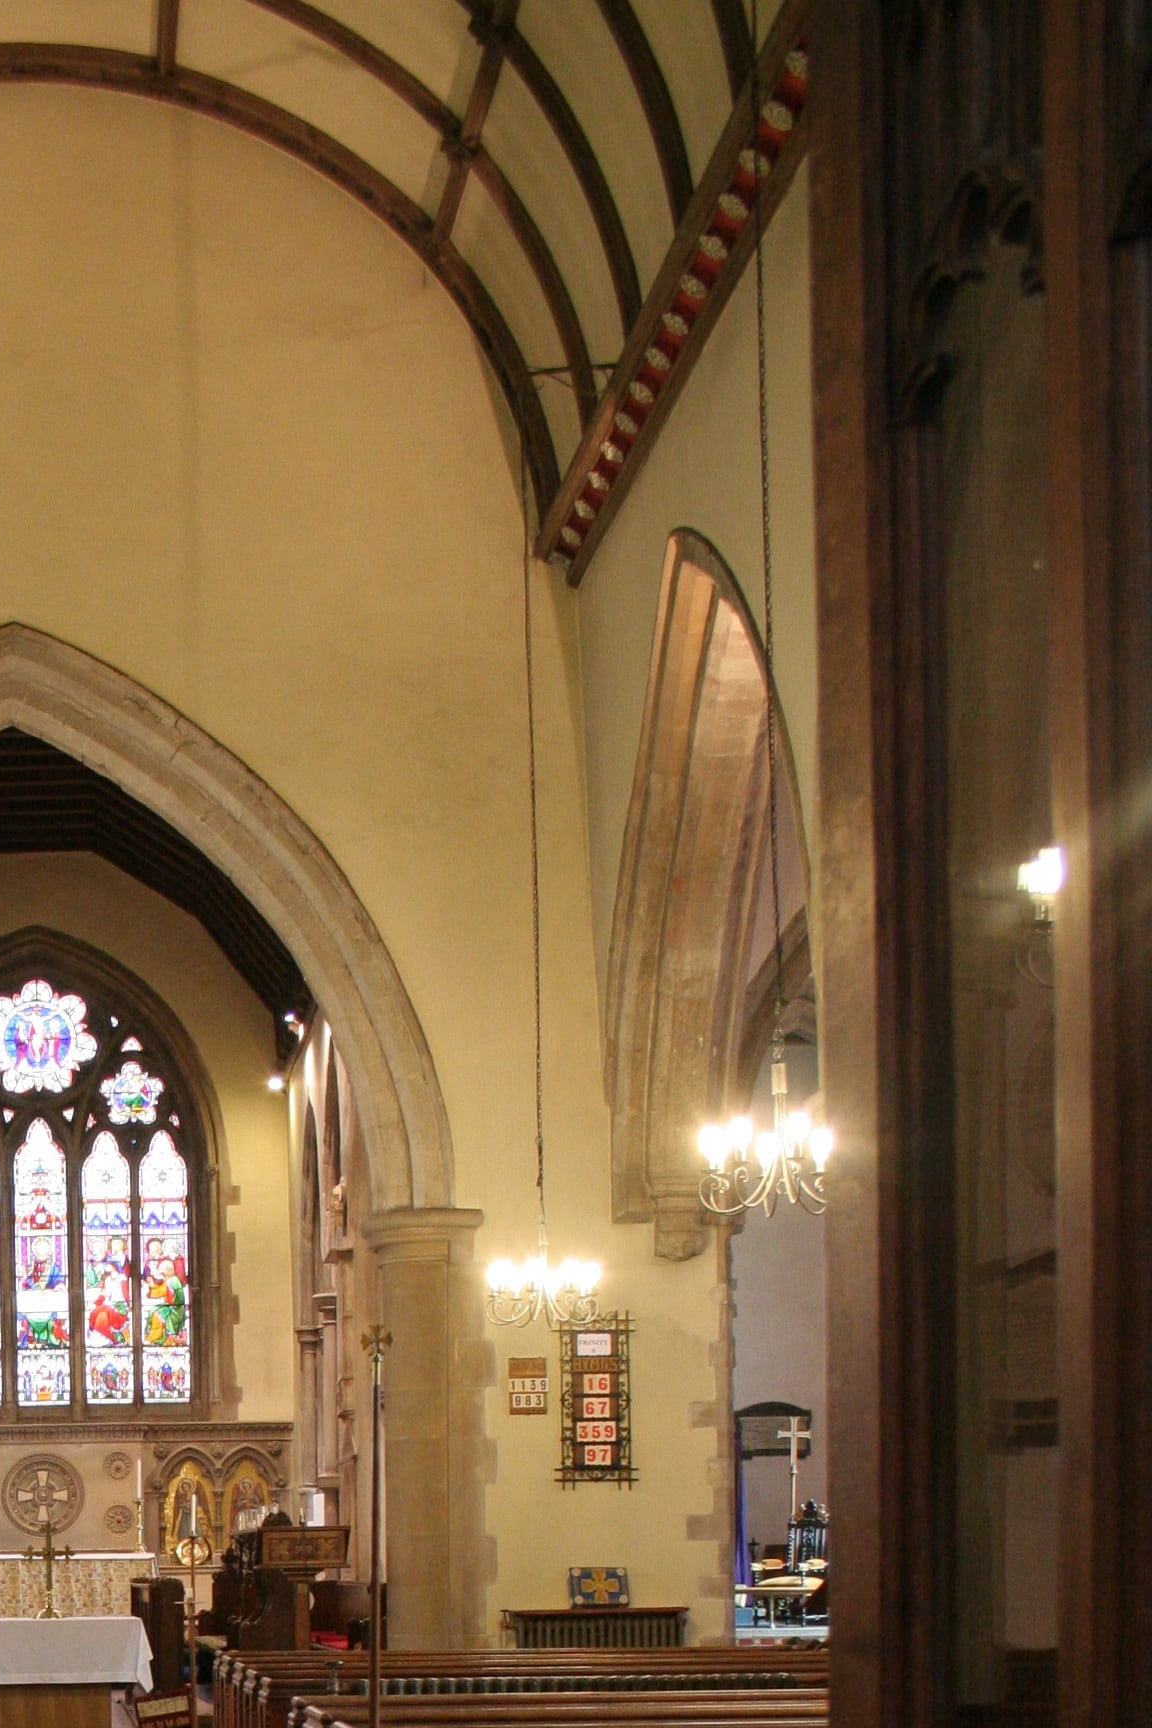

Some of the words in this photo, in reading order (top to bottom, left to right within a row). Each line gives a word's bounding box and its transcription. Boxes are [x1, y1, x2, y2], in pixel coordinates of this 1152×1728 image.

[573, 1359, 617, 1371] HYMNS
[511, 1379, 547, 1391] 1139
[587, 1377, 608, 1391] 16
[585, 1402, 608, 1415] 67
[579, 1425, 614, 1439] 359
[586, 1448, 609, 1462] 97
